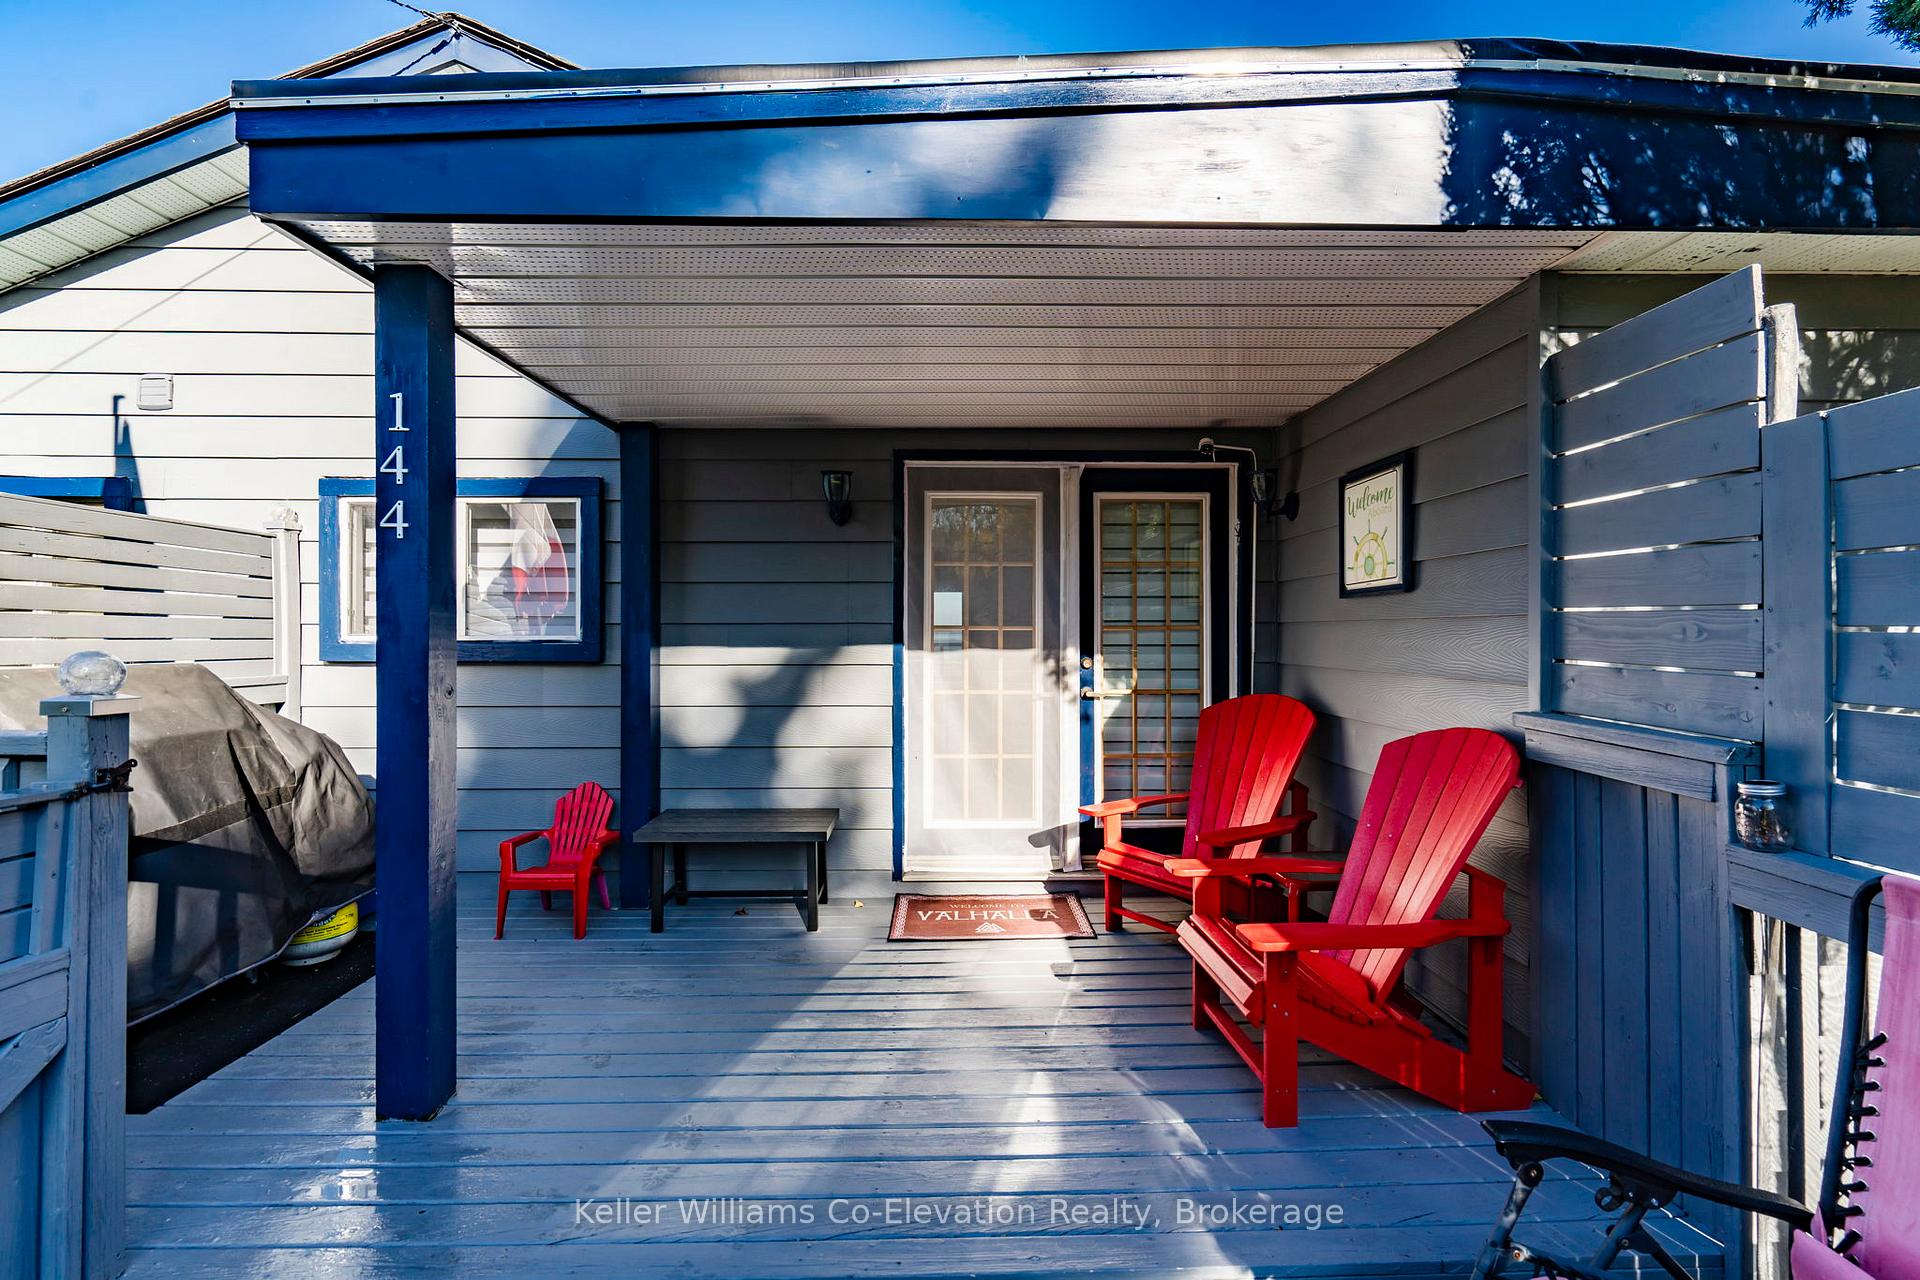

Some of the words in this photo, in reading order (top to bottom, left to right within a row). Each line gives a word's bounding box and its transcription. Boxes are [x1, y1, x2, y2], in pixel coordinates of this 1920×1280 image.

[379, 392, 410, 539] 144
[1347, 485, 1394, 518] Welcome
[917, 909, 1060, 921] VALHALLA
